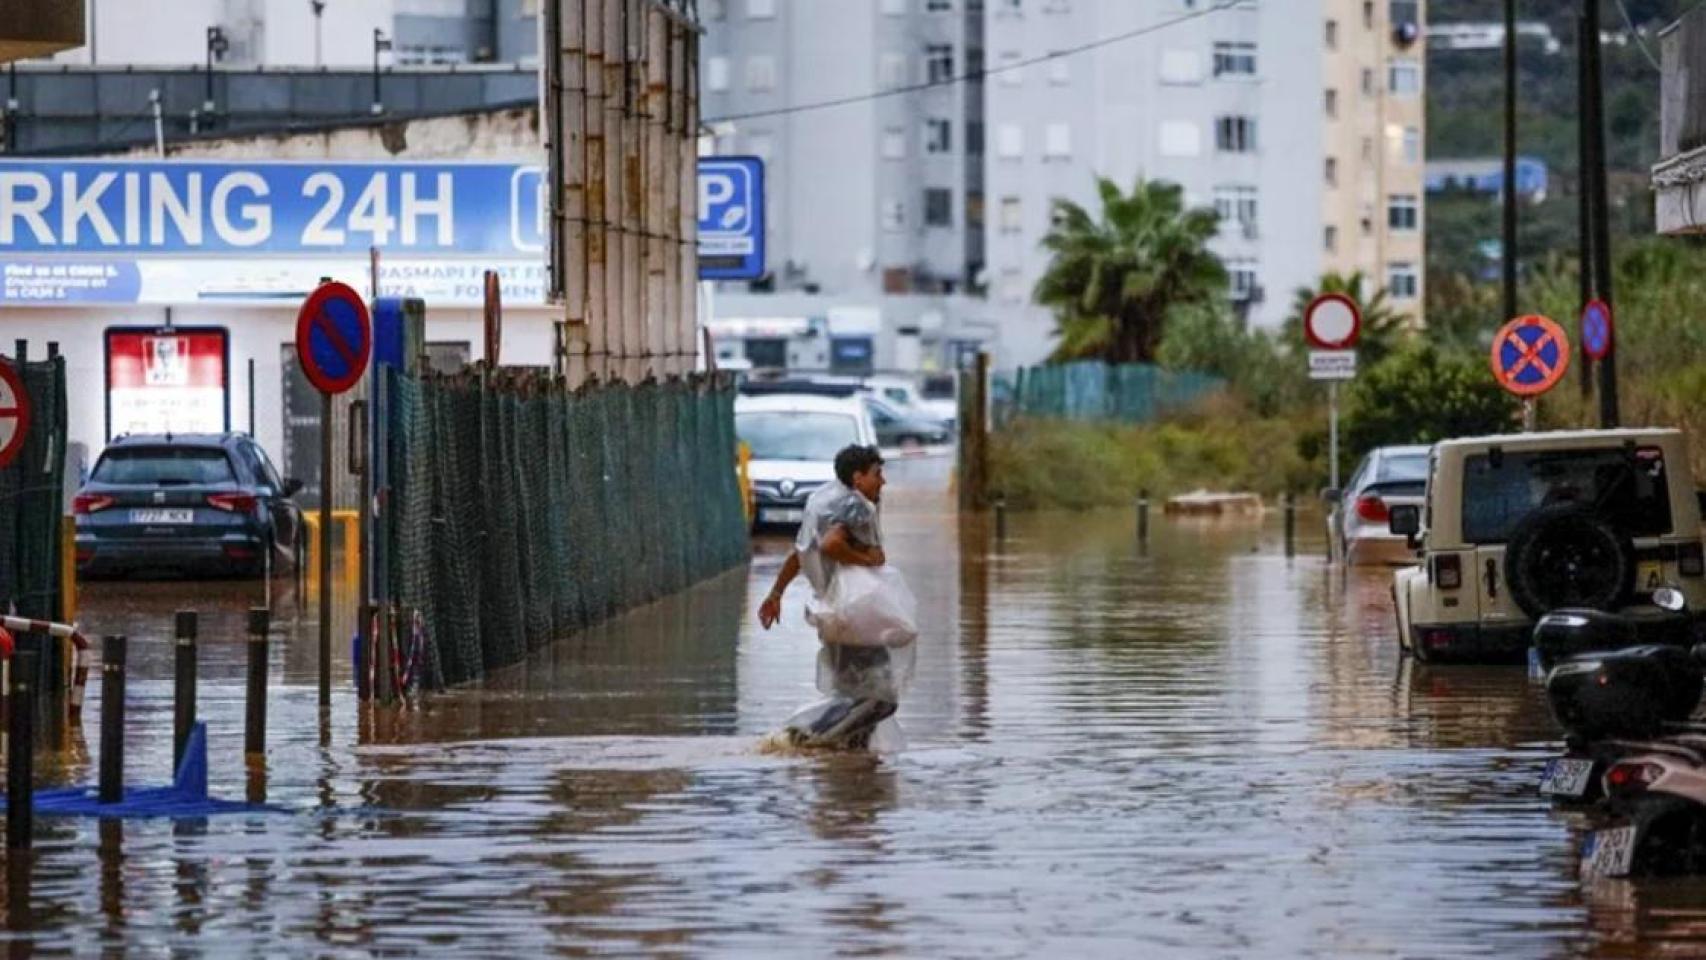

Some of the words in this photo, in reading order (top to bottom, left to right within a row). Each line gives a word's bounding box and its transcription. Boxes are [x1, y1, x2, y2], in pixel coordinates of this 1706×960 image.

[0, 171, 272, 246] RKING
[301, 172, 453, 246] 24H
[698, 175, 733, 221] P
